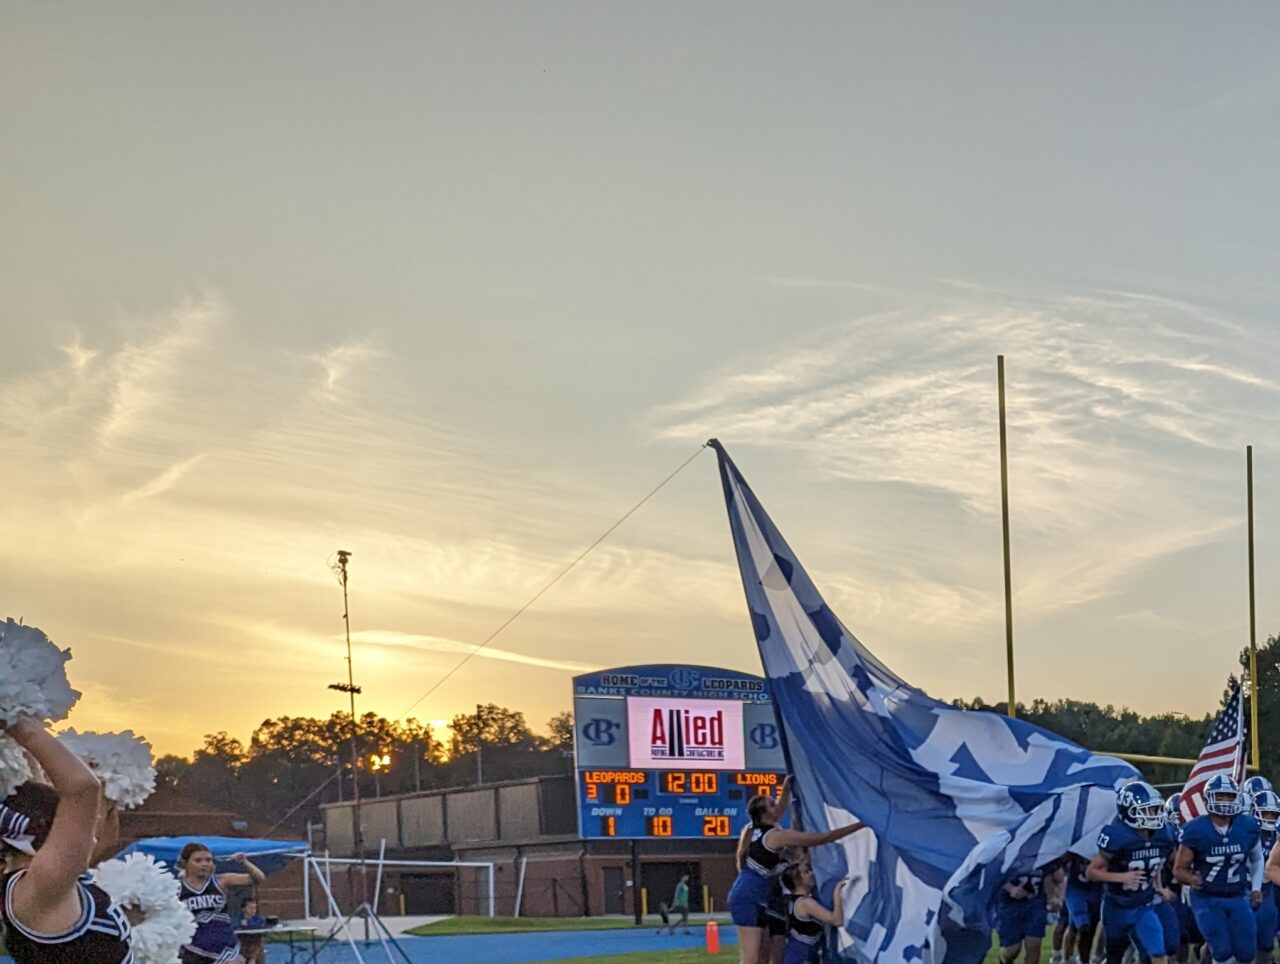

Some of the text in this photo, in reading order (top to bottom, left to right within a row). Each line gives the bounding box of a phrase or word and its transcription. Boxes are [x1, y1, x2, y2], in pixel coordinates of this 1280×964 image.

[602, 675, 638, 687] HOME
[703, 679, 763, 691] LEOPARDS
[577, 687, 768, 700] BANKS COUNTY HIGH SCHO
[585, 771, 646, 783] LEOPARDS
[666, 772, 717, 793] 12:00
[736, 774, 777, 785] LIONS
[587, 784, 597, 798] 3
[616, 784, 630, 804] 0
[591, 808, 738, 816] DOWN TO GO BALL ON
[608, 816, 615, 836] 1
[653, 816, 671, 836] 10
[704, 816, 729, 836] 20
[1132, 848, 1160, 860] LEOPARDS
[1211, 844, 1241, 855] LEOPARDS
[1206, 853, 1245, 883] 72
